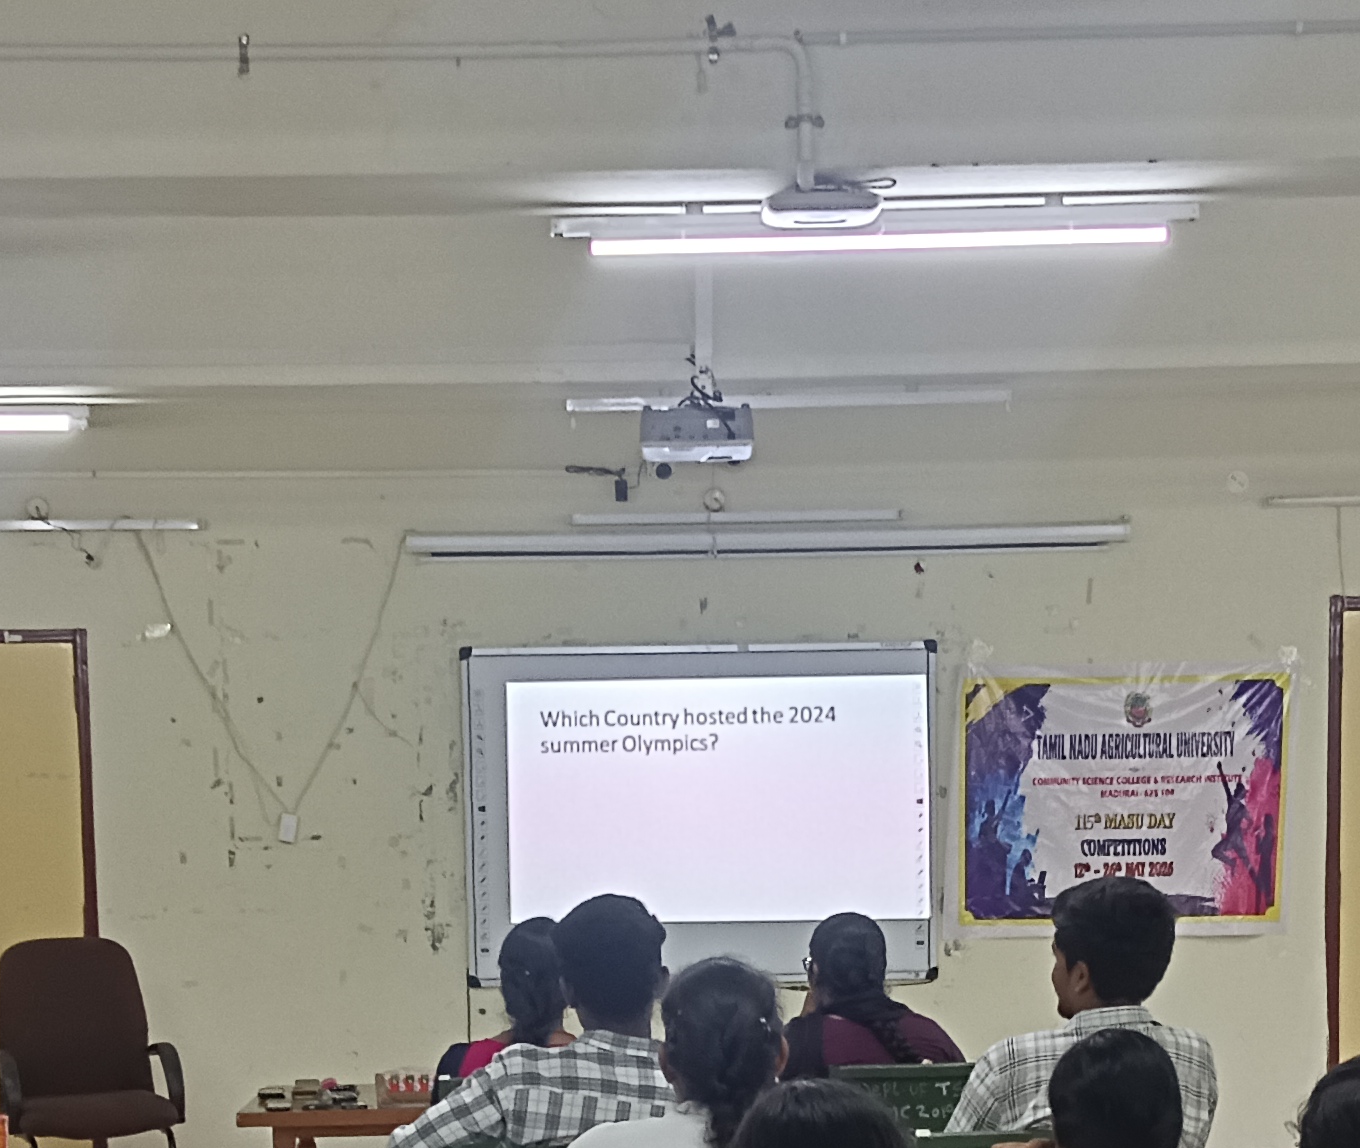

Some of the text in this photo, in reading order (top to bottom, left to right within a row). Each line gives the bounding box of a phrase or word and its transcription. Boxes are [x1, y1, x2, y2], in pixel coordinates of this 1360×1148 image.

[540, 706, 837, 730] Which Country hosted the 2024
[540, 733, 719, 756] summer Olympics?
[1037, 731, 1235, 760] TAMIL NADU AGRICULTURAL UNIVERSITY
[1032, 777, 1080, 786] COMMUNITY
[1082, 777, 1114, 786] SCIENCE
[1116, 776, 1151, 785] COLLEGE
[1161, 775, 1202, 784] RESEARCH
[1147, 812, 1177, 829] DAY
[1080, 837, 1167, 857] COMPETITIONS
